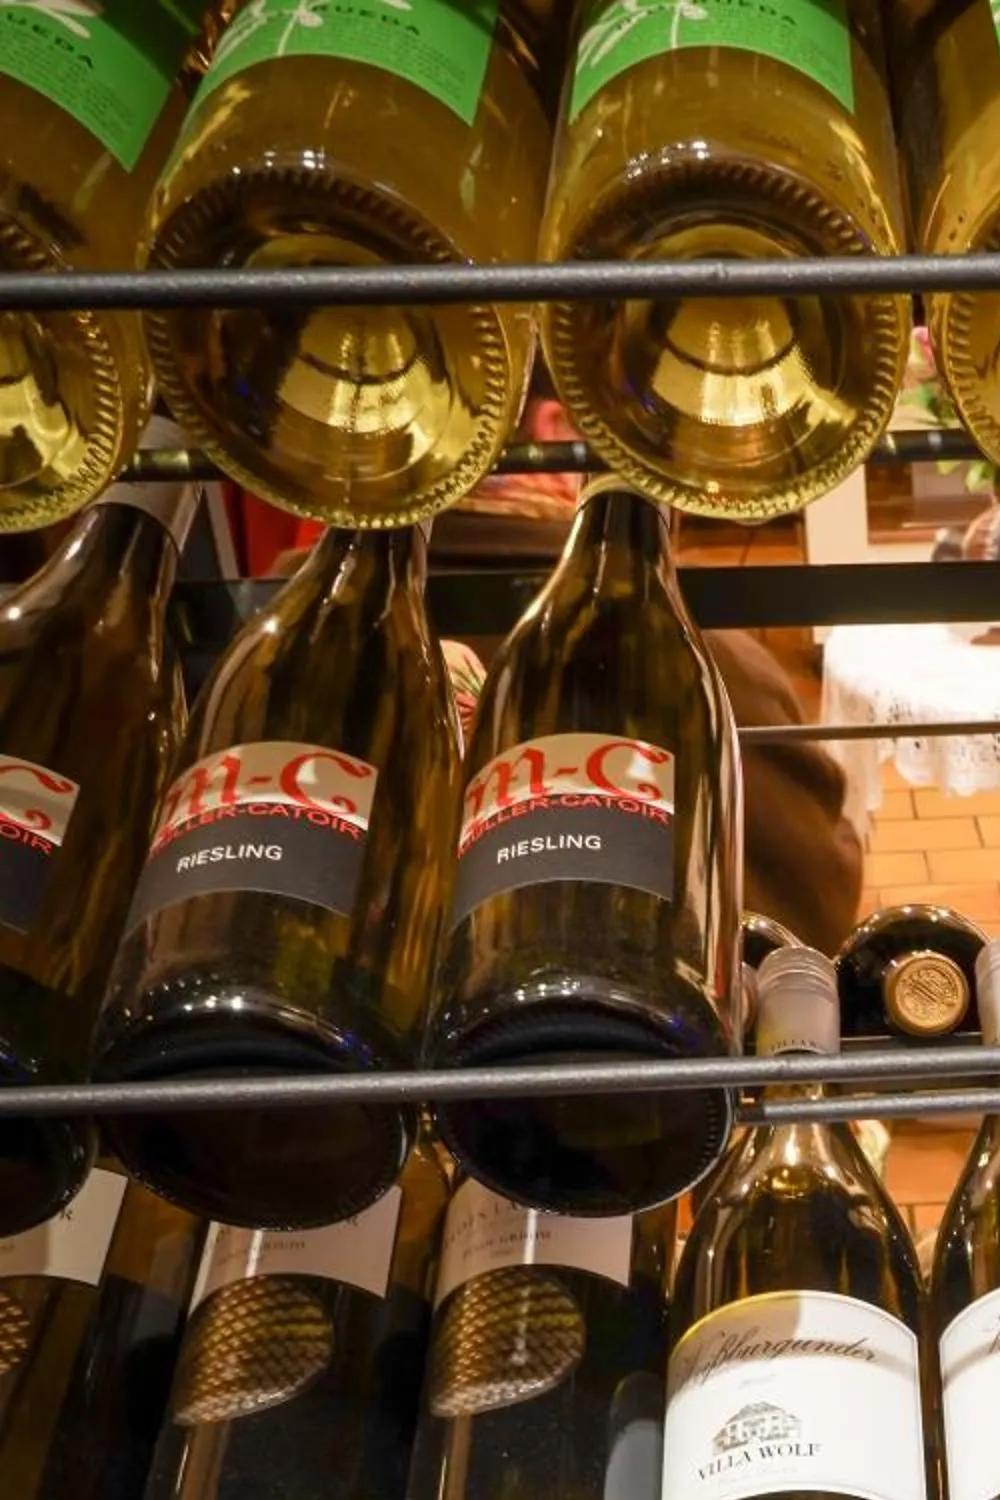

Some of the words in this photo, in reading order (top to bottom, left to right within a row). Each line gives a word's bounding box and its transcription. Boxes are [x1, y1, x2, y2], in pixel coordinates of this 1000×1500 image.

[176, 843, 283, 874] RIESLING
[496, 833, 602, 864] RIESLING
[697, 1449, 753, 1481] VILLA
[758, 1441, 821, 1460] WOLF
